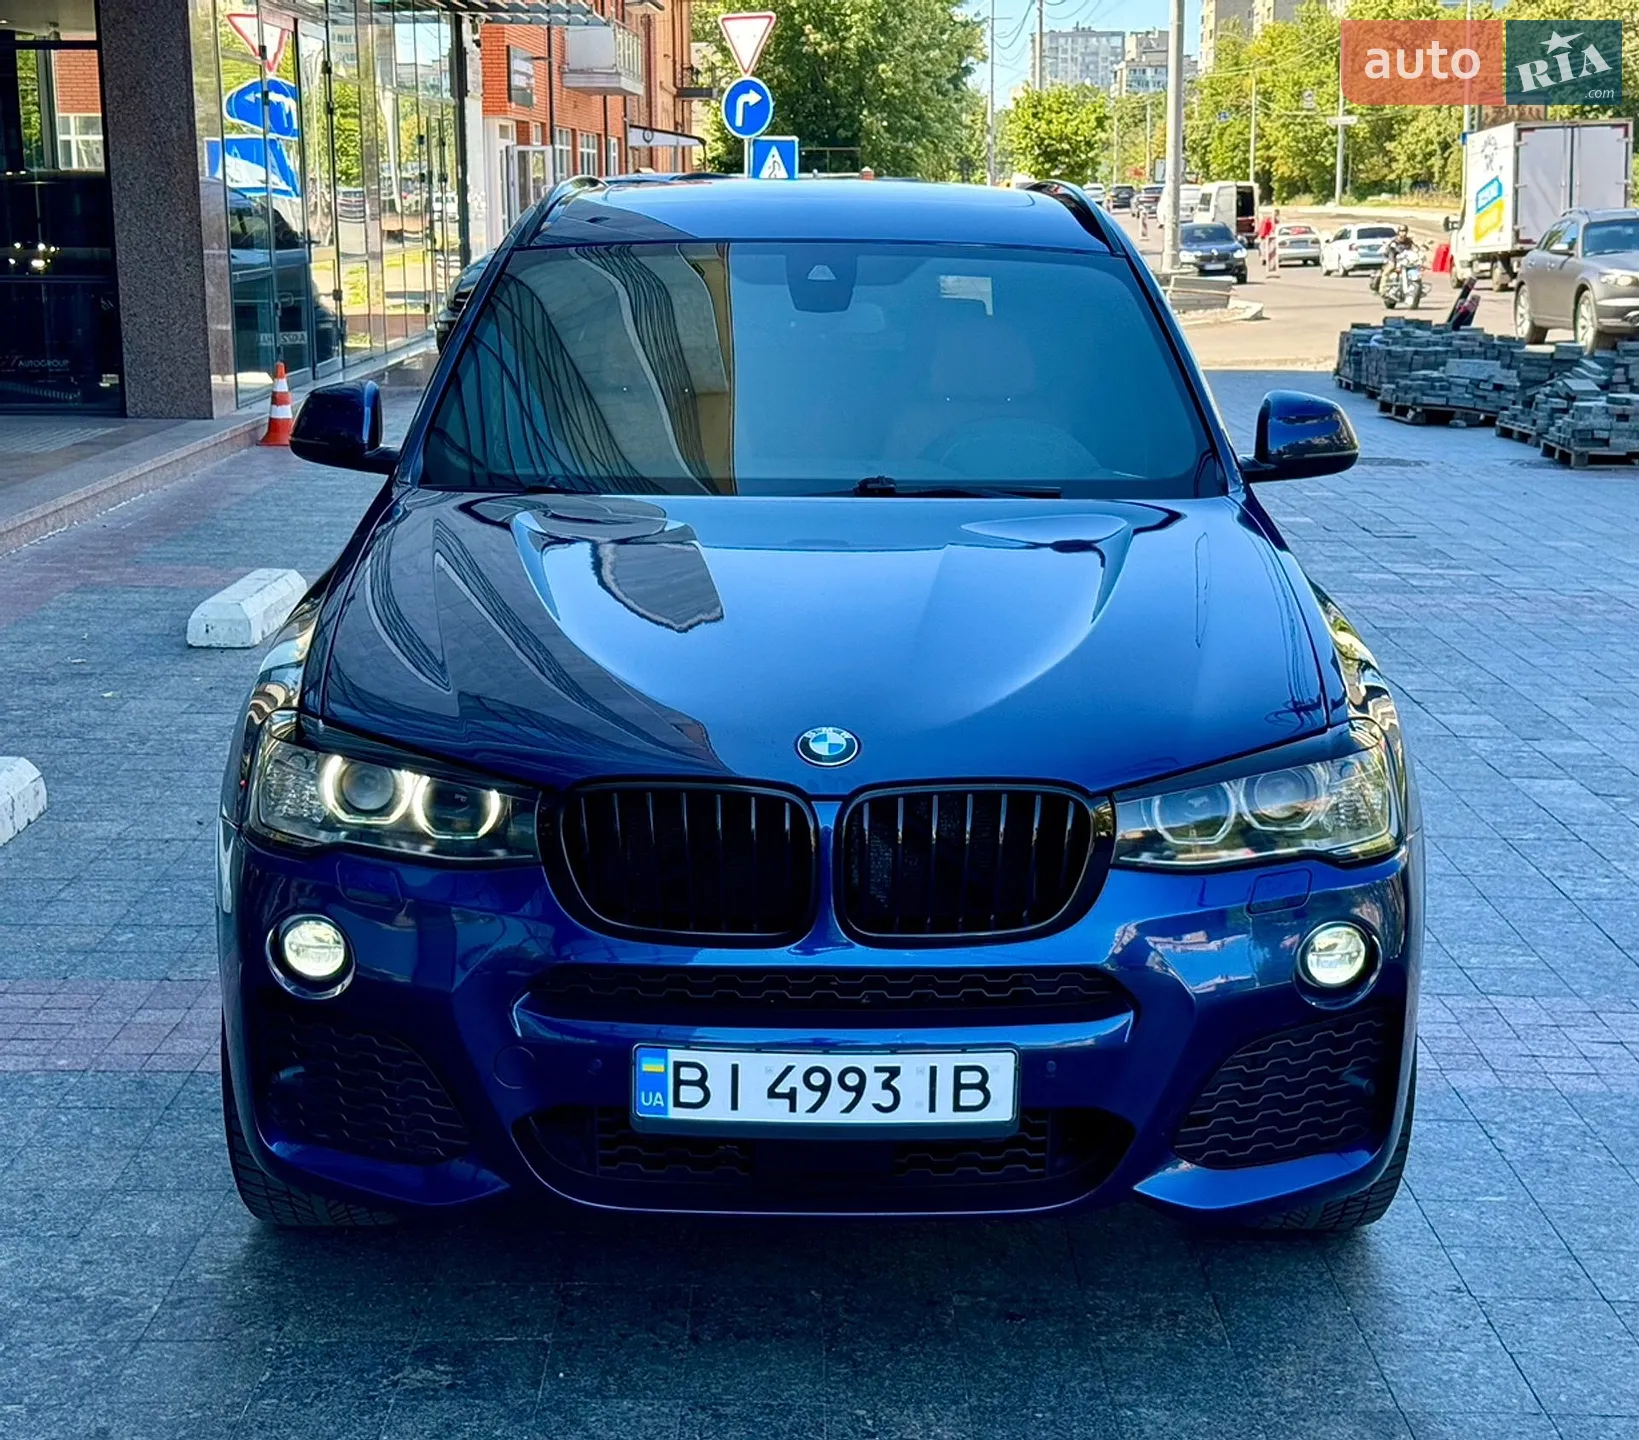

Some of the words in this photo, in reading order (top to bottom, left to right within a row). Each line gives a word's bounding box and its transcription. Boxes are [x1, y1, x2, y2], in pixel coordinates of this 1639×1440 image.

[640, 1090, 665, 1107] UA
[672, 1060, 739, 1112] BI
[766, 1064, 901, 1114] 4993
[928, 1064, 992, 1114] IB
